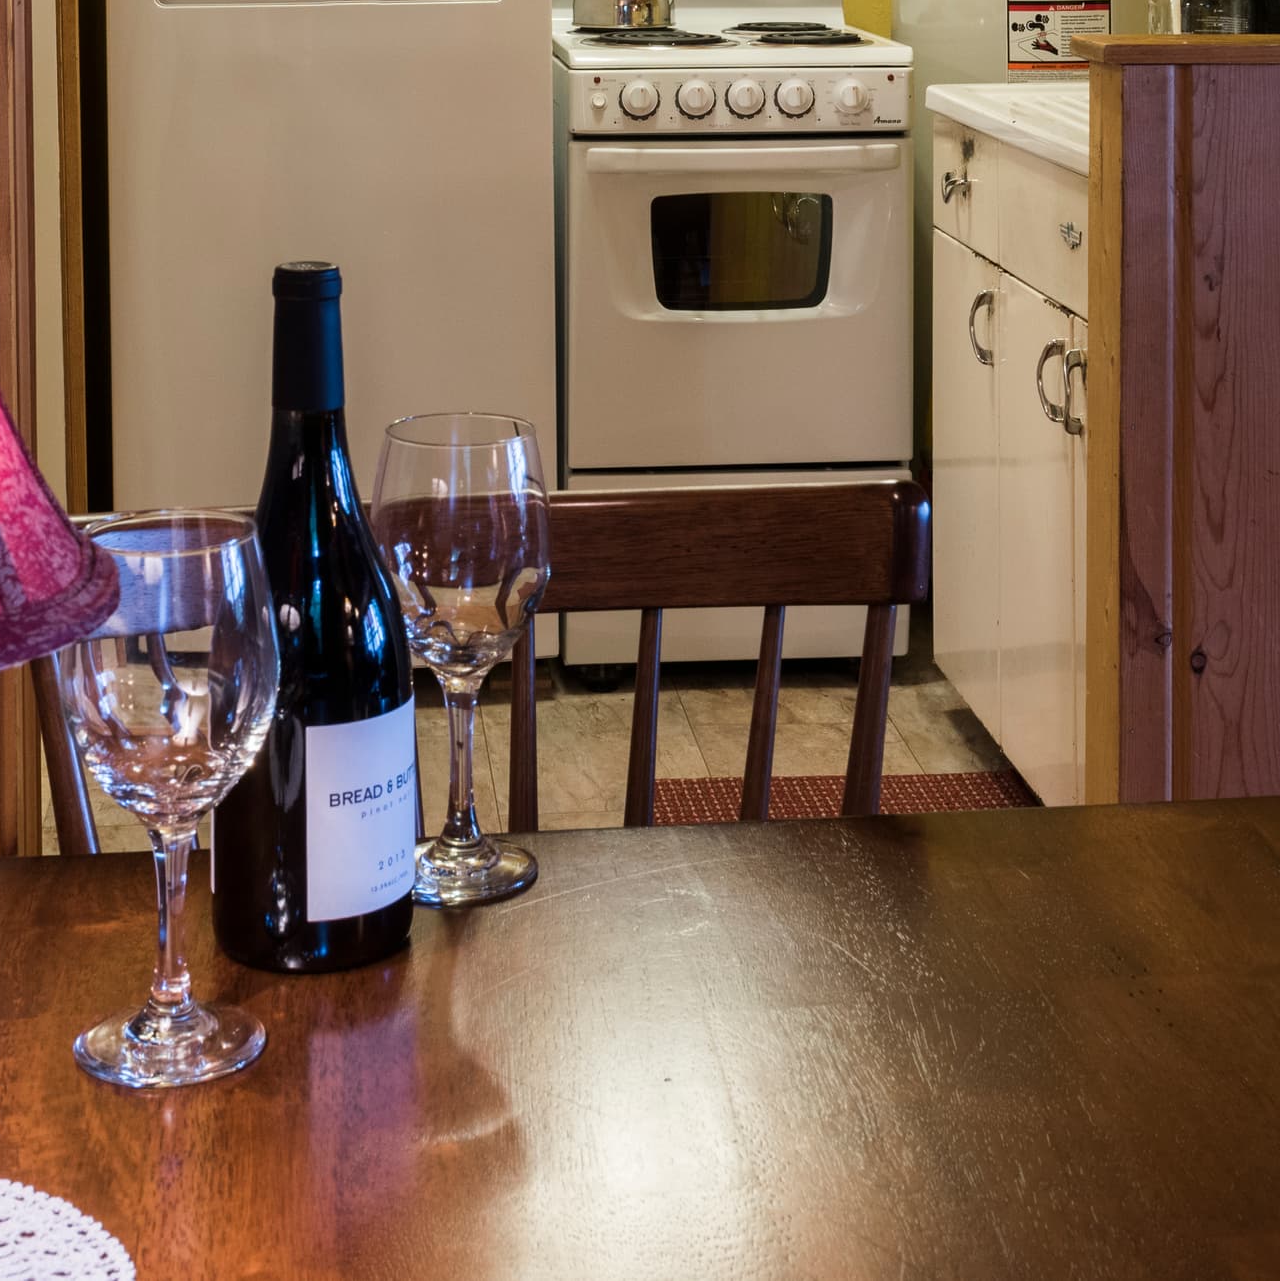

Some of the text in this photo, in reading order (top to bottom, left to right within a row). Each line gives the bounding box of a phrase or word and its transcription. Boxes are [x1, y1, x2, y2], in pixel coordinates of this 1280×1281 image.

[873, 116, 902, 125] Amana
[329, 784, 383, 808] BREAD
[386, 778, 394, 795] &
